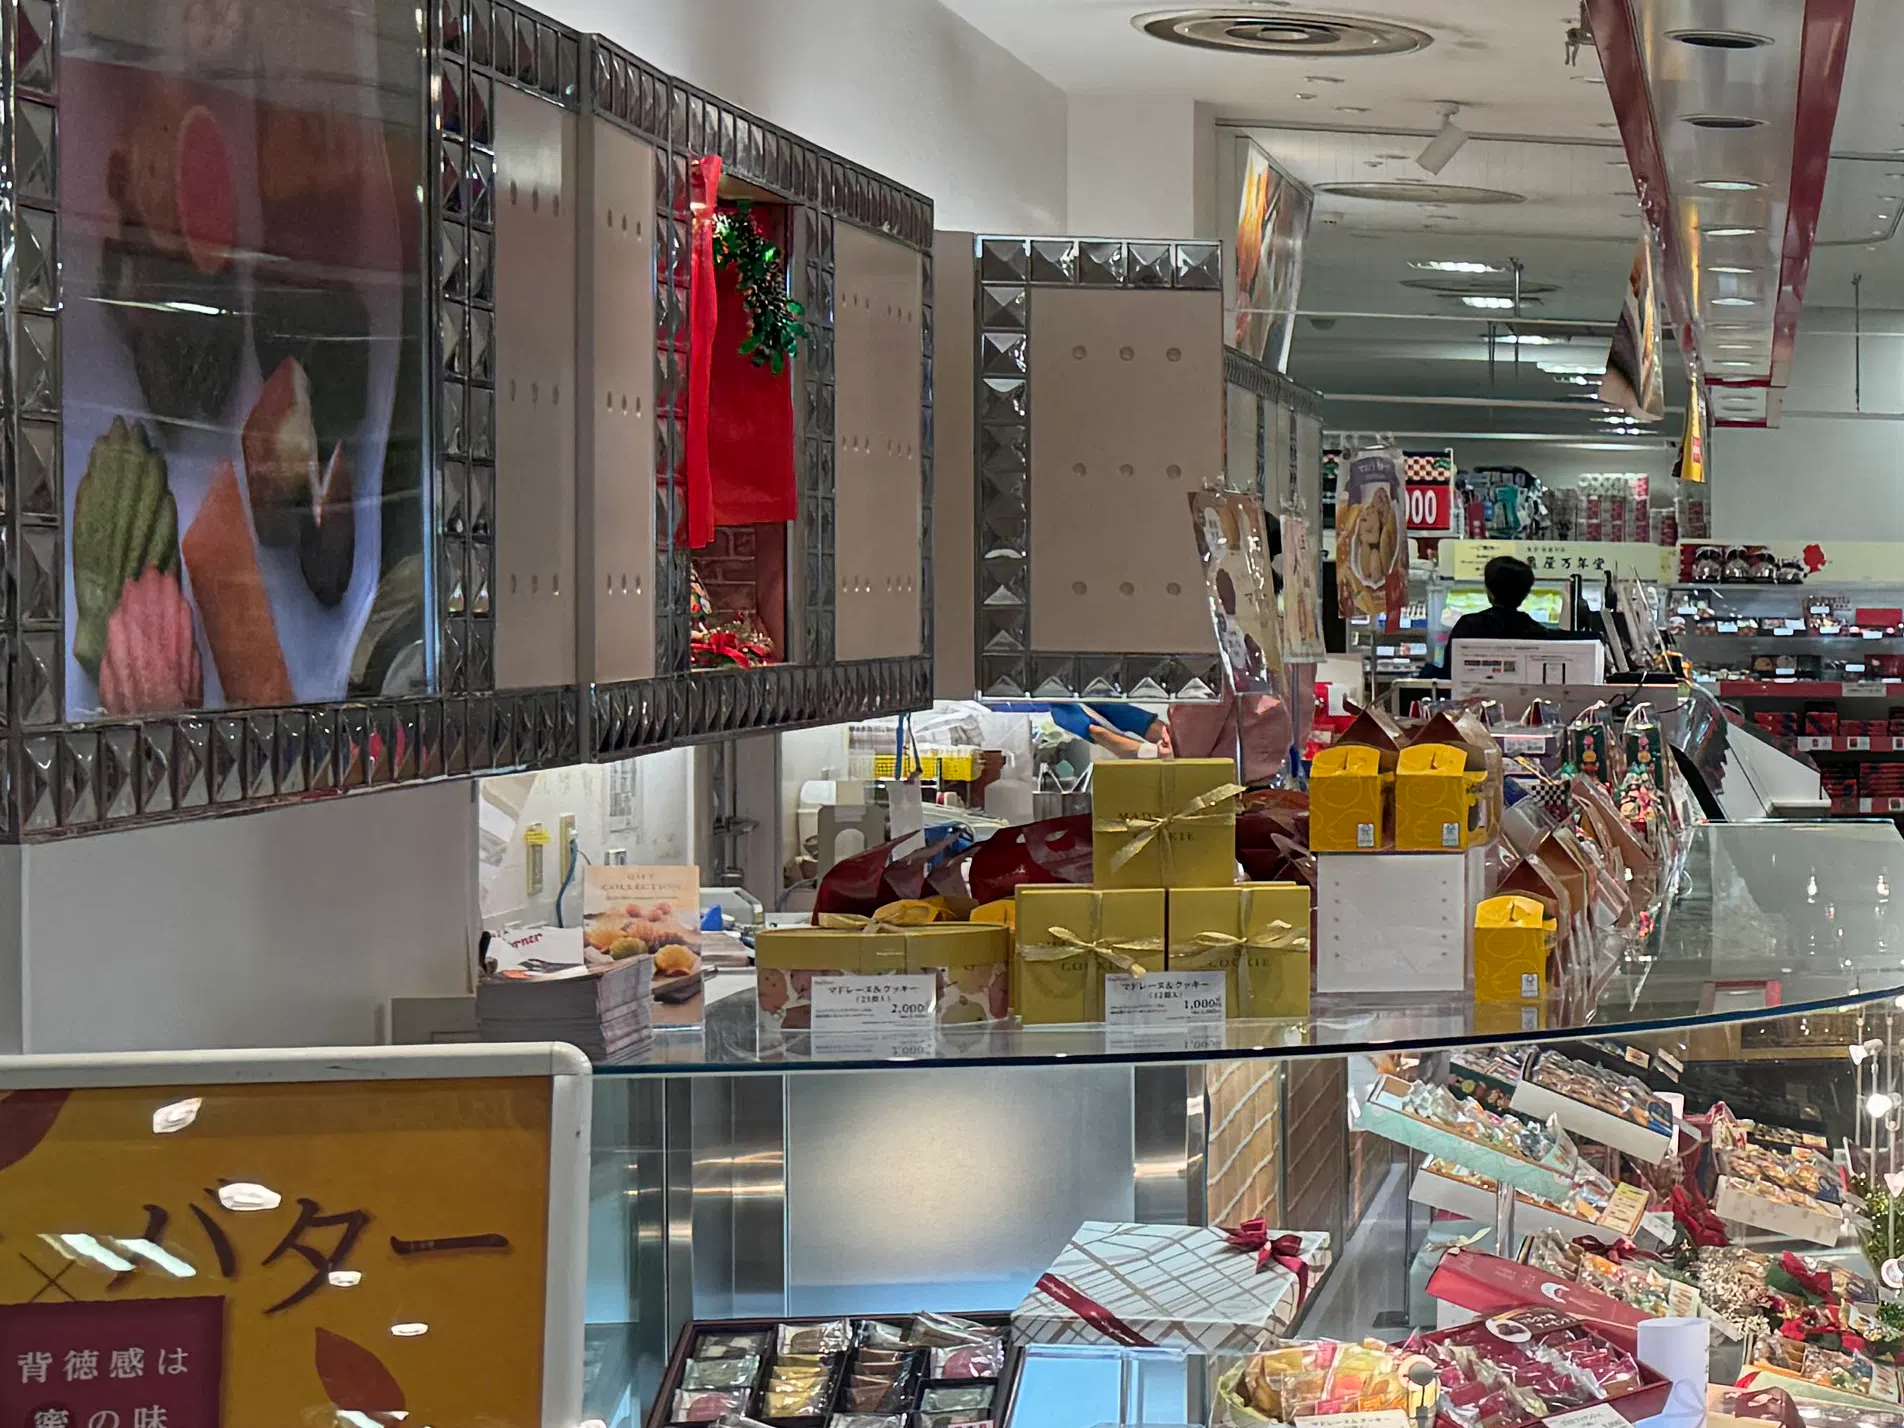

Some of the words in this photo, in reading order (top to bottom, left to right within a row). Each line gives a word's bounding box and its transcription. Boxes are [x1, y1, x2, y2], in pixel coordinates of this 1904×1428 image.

[105, 1176, 512, 1316] バター
[17, 1347, 190, 1384] 背徳感は
